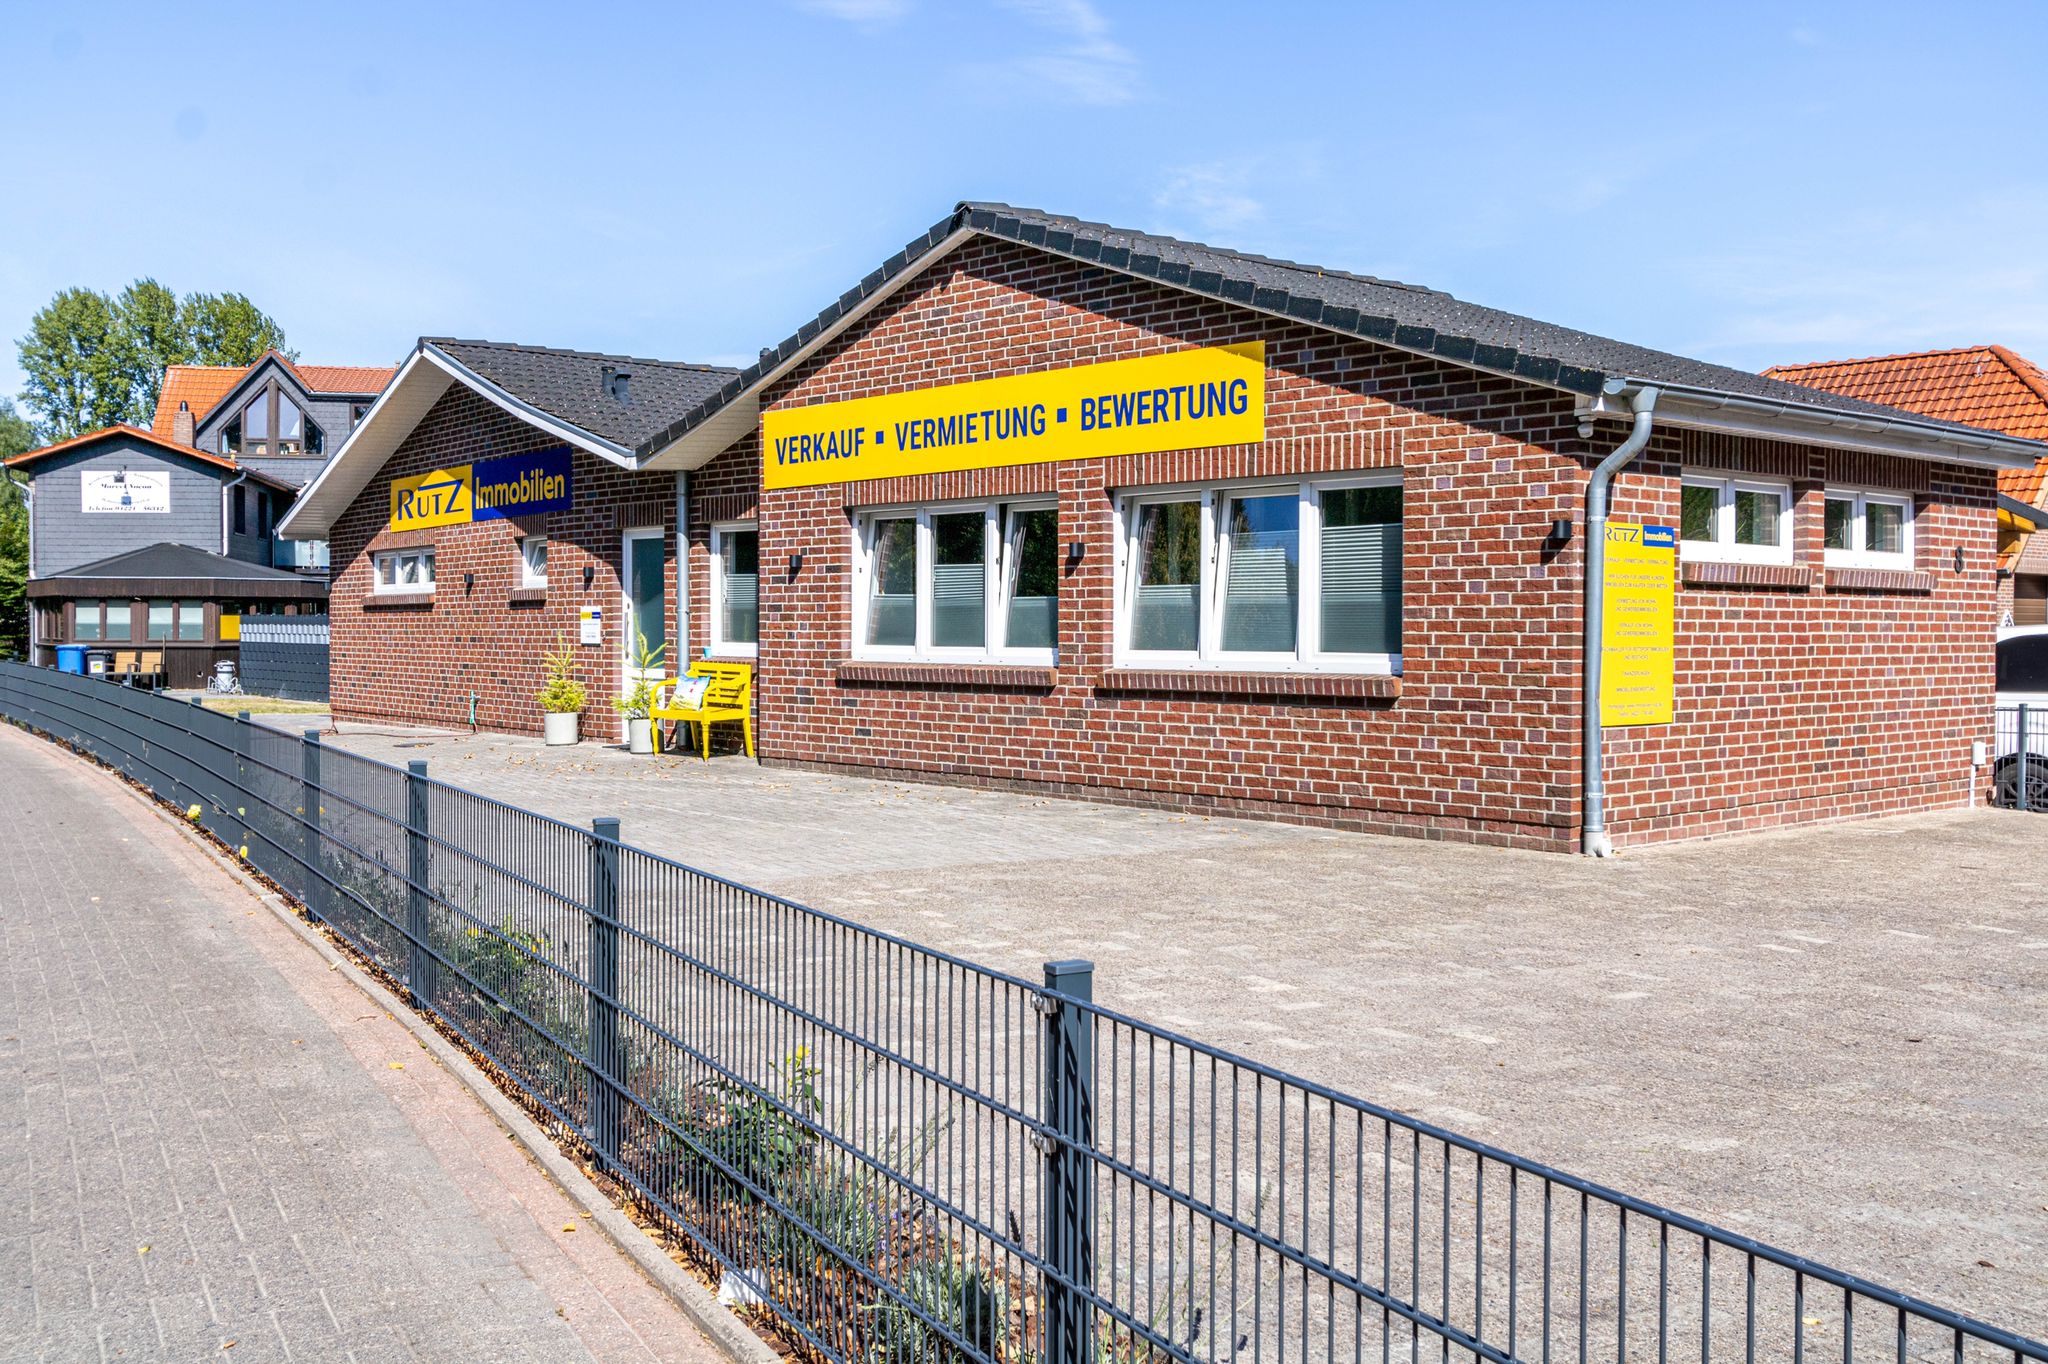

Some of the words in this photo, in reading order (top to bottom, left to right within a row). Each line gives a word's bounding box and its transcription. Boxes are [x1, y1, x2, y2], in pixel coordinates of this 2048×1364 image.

[775, 427, 866, 466] VERKAUF
[894, 403, 1046, 452] VERMIETUNG
[1080, 377, 1248, 432] BEWERTUNG
[397, 478, 465, 521] RUTZ
[475, 468, 566, 510] Immobilien
[1954, 545, 1965, 575] 8
